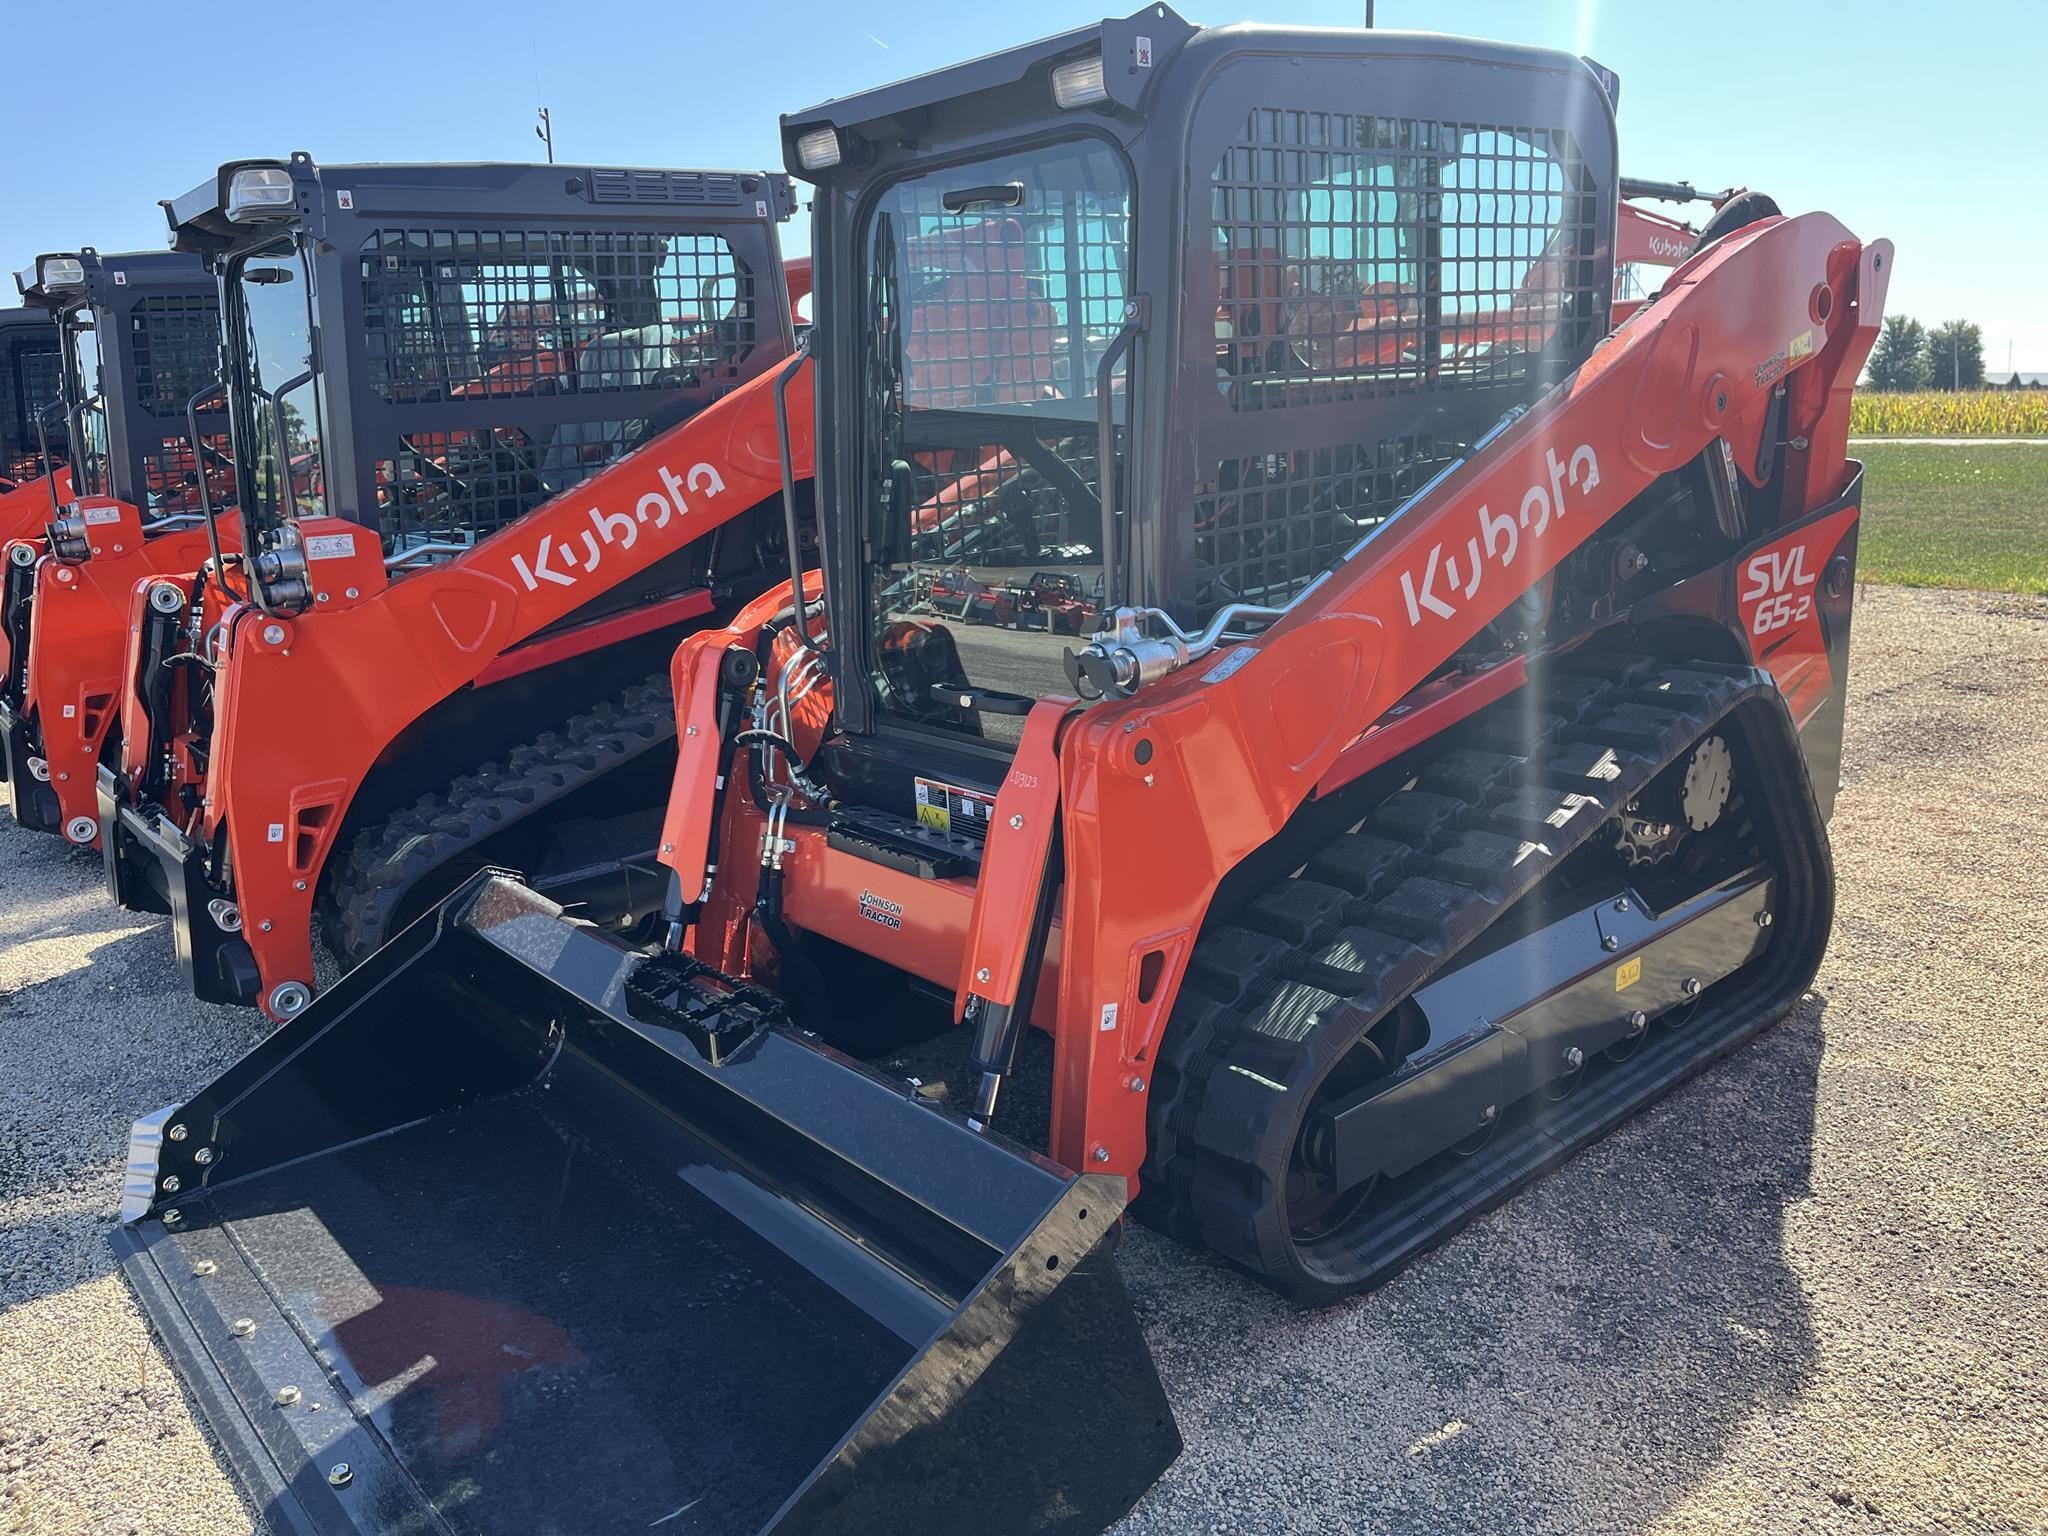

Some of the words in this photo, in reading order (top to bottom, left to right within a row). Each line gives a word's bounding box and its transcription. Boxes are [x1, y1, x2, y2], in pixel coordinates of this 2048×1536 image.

[510, 462, 726, 592] Kubota
[1400, 444, 1600, 627] Kubota
[1742, 544, 1816, 603] SVL
[1753, 592, 1811, 635] 65-2
[859, 889, 903, 915] JOHNSON
[859, 902, 901, 930] TRACTOR
